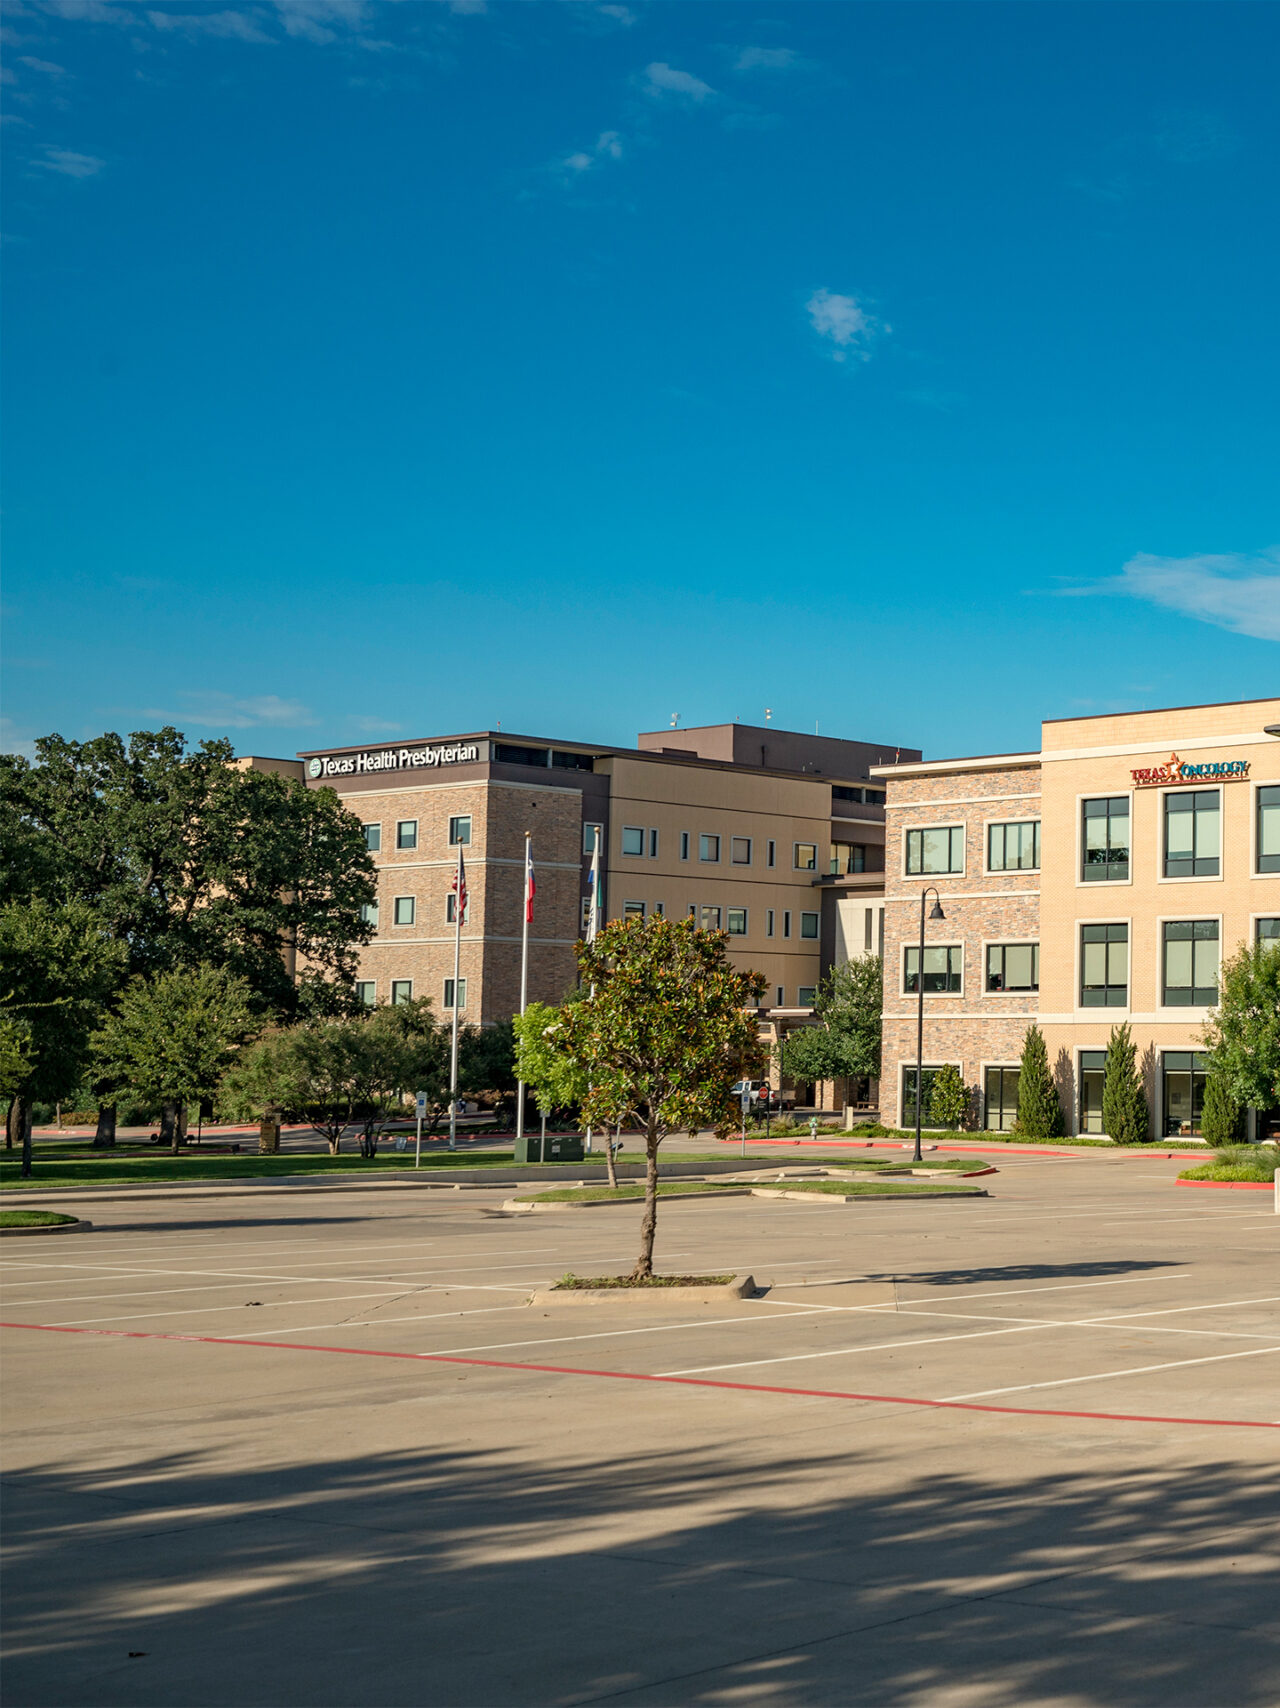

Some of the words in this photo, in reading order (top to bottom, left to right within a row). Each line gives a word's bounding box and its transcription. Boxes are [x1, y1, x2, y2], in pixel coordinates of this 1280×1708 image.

[321, 757, 354, 775] Texas
[357, 752, 397, 771] Health
[399, 743, 477, 767] Presbyterian
[1130, 767, 1167, 780] TEXAS
[1181, 761, 1248, 776] ONCOLOGY
